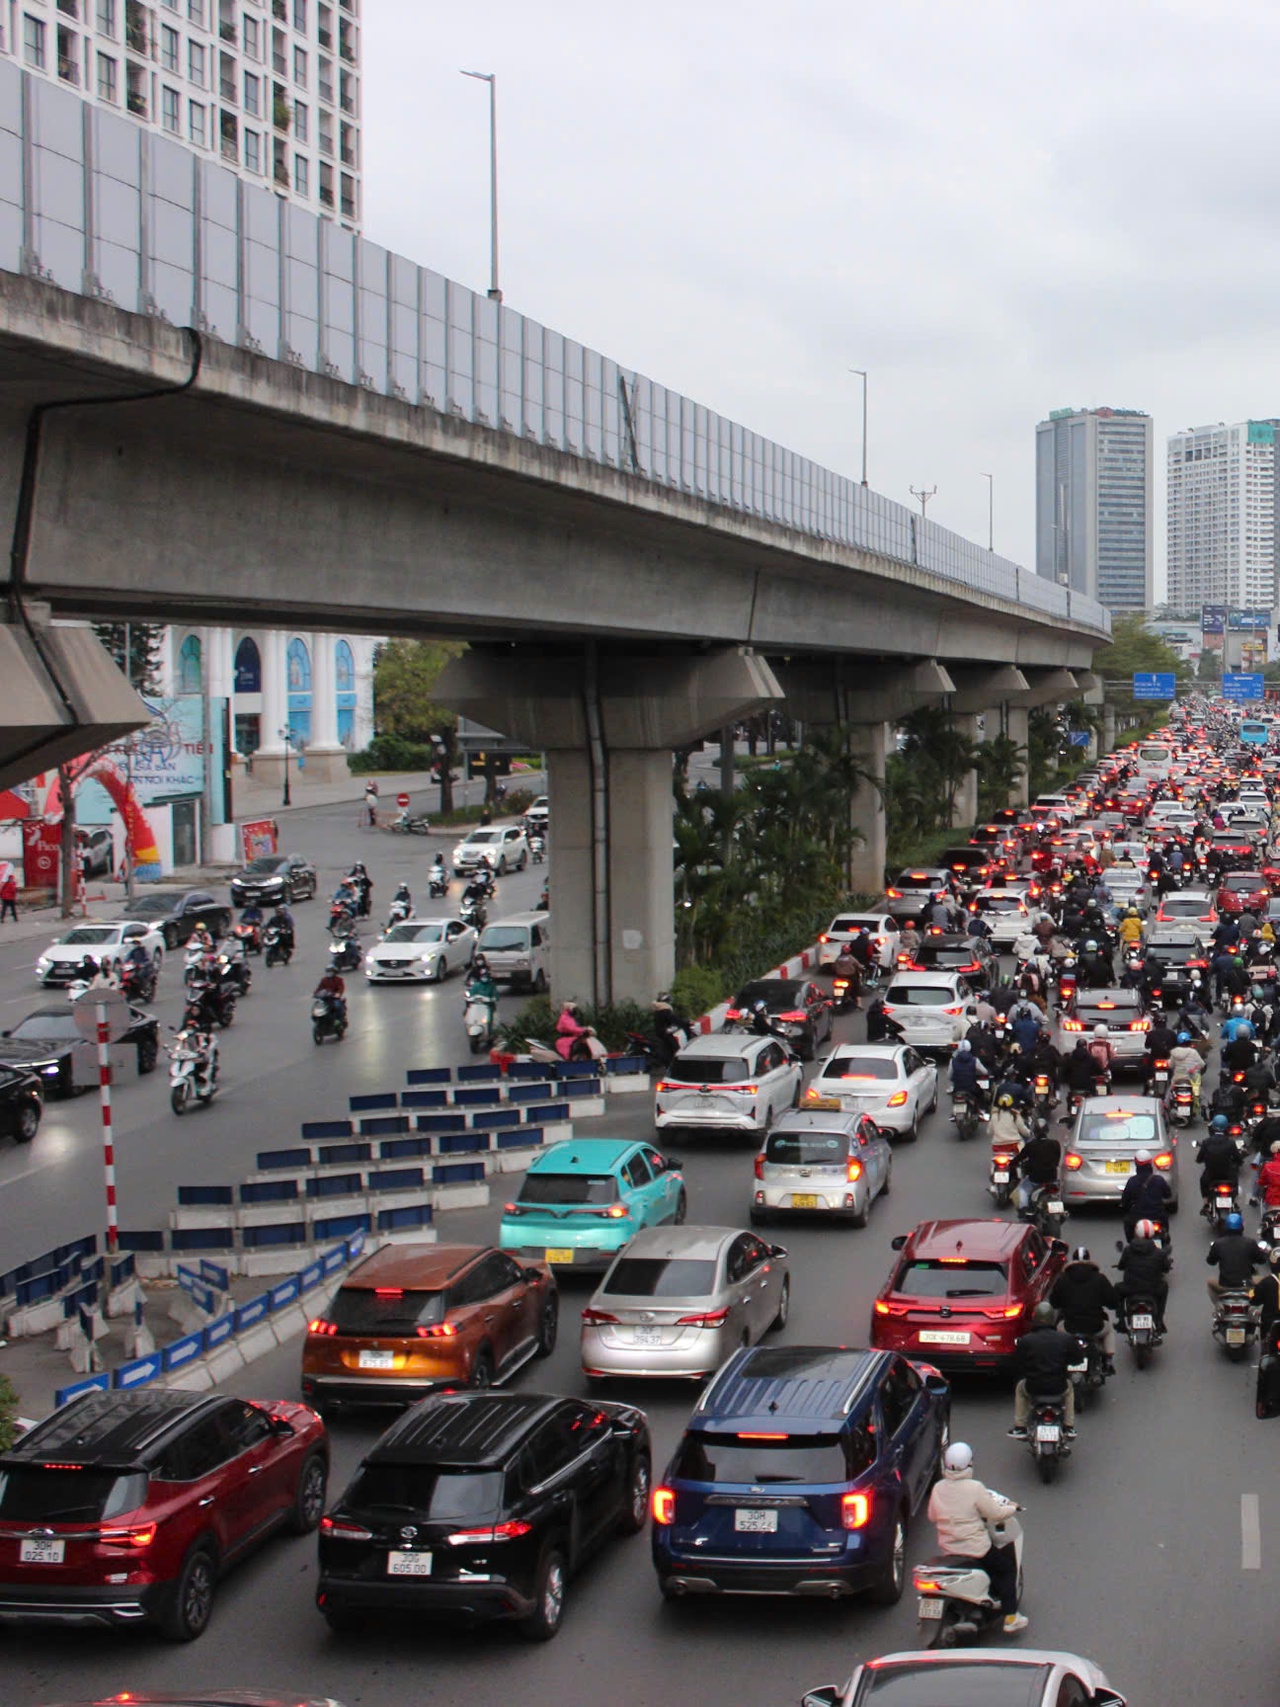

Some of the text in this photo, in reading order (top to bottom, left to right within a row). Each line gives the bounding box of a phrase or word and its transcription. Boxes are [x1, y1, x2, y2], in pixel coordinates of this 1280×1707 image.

[747, 1511, 765, 1520] 30H
[34, 1541, 52, 1551] 30H
[25, 1551, 60, 1562] 025.10
[392, 1563, 427, 1574] 605.00
